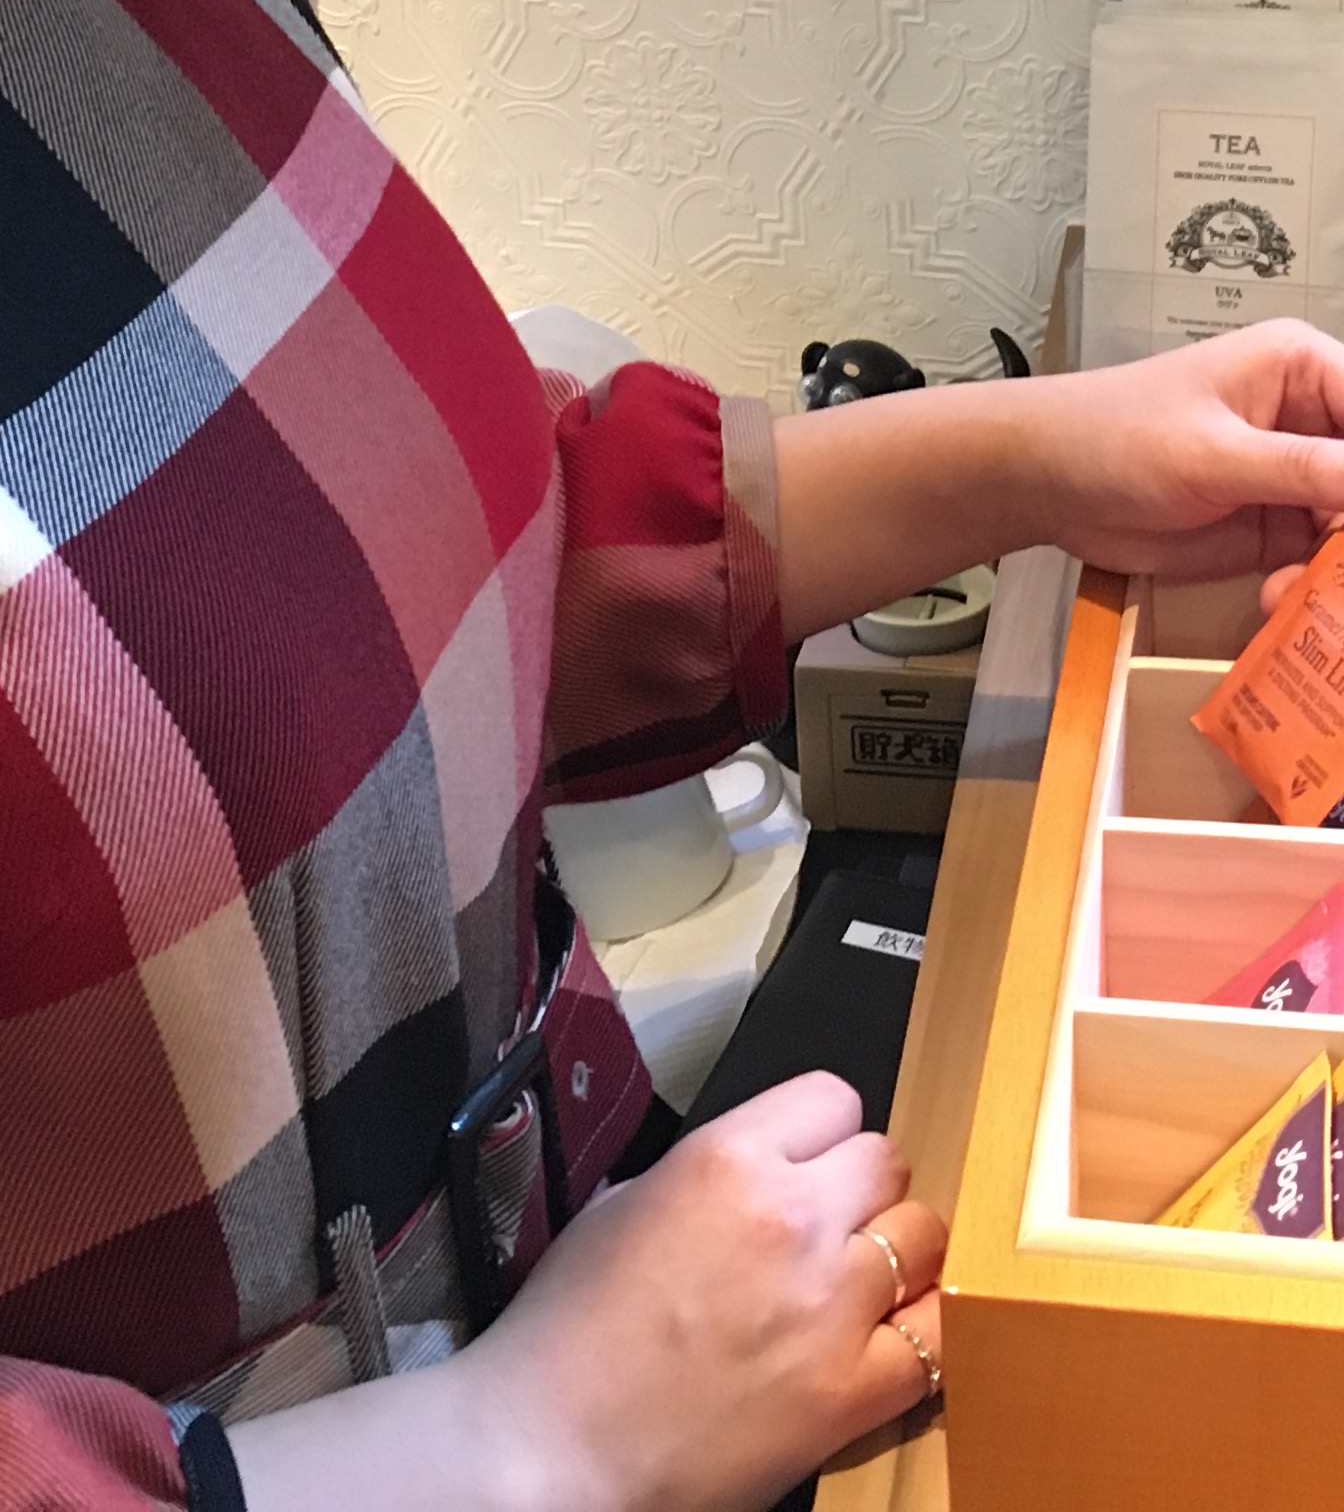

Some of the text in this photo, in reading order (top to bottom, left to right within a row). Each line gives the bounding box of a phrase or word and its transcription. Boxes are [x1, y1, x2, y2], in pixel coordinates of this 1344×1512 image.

[1209, 133, 1262, 157] TEA
[1215, 286, 1243, 300] UVA
[1293, 625, 1329, 674] Slim
[1267, 1139, 1308, 1222] yogi
